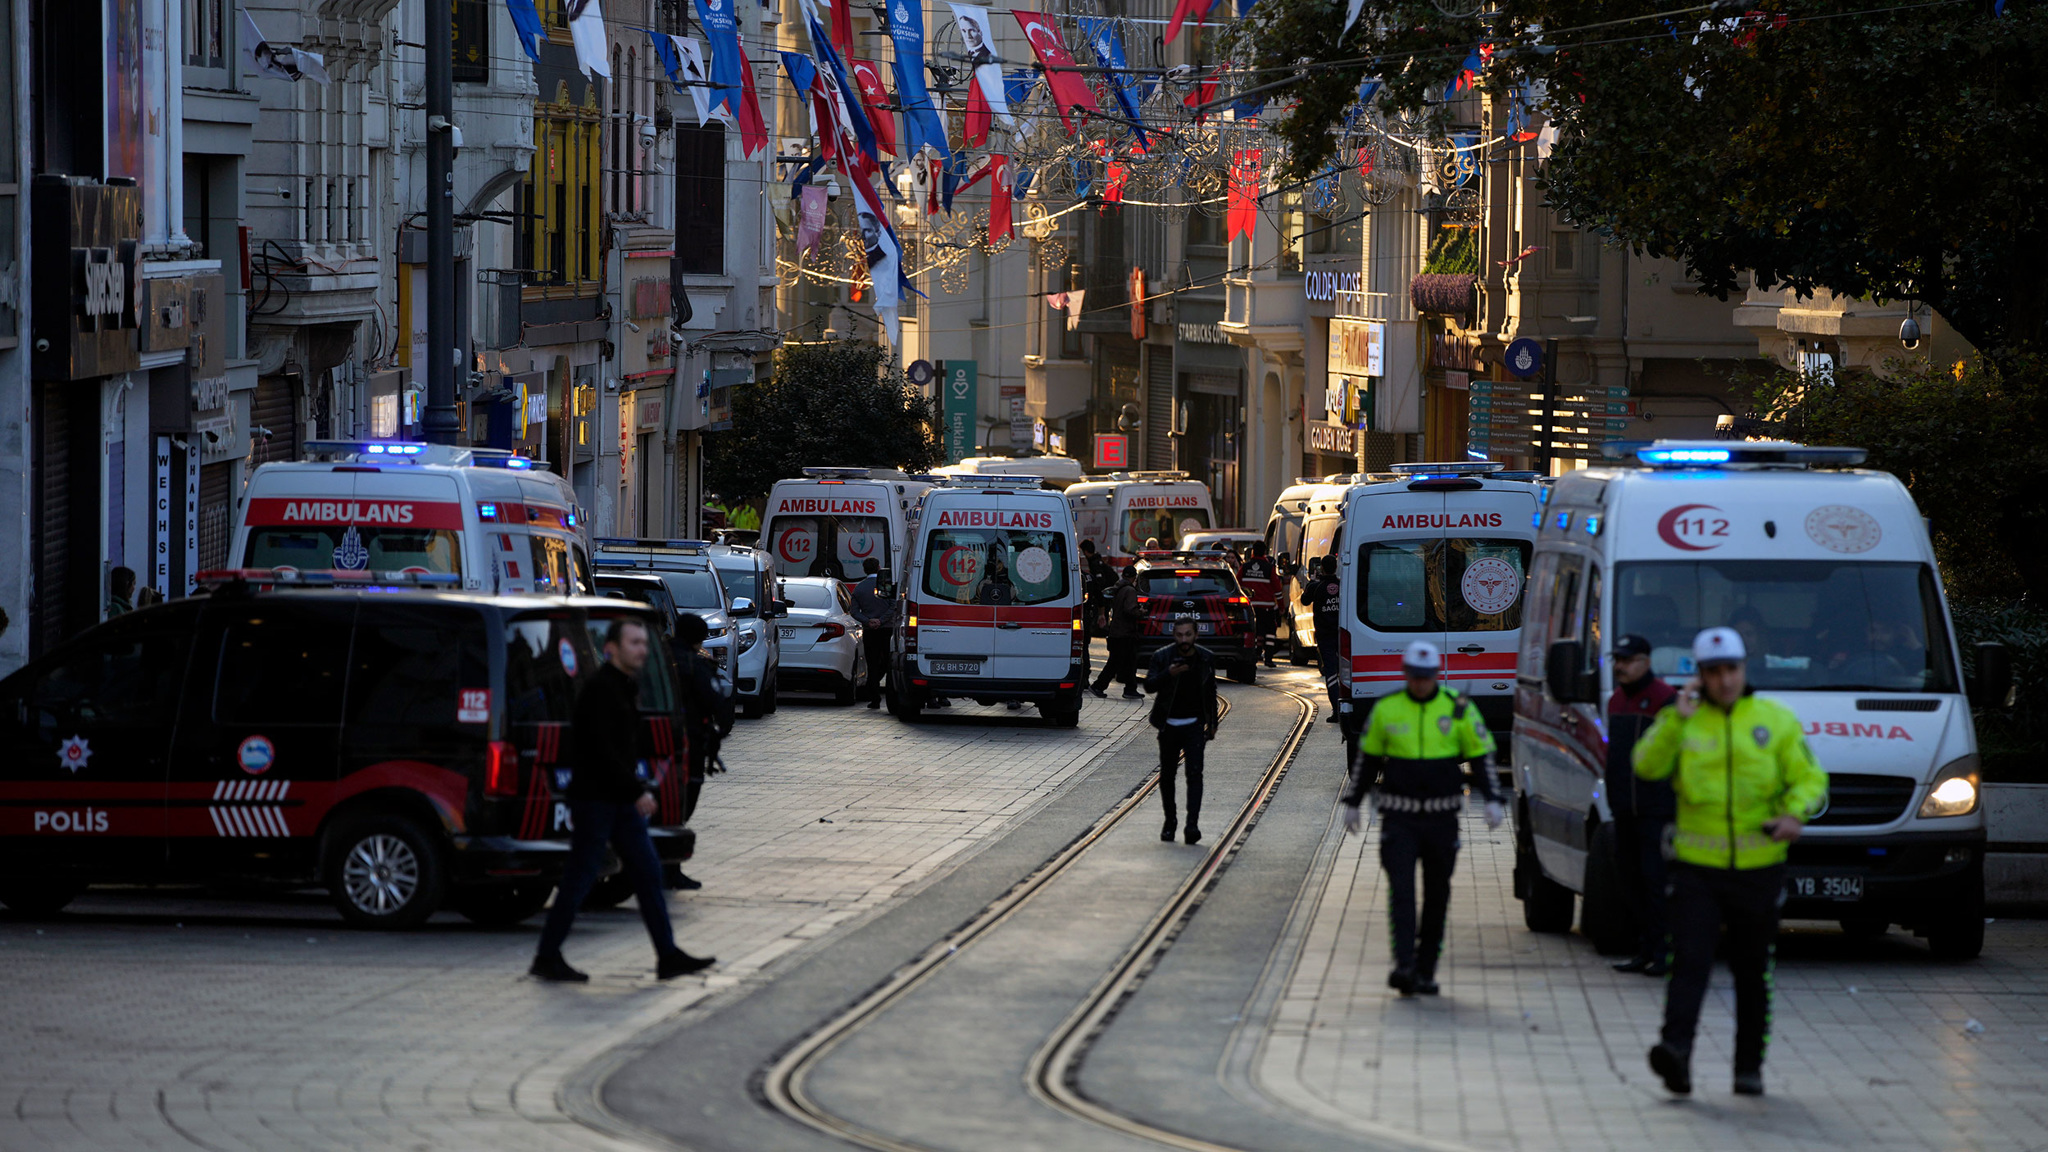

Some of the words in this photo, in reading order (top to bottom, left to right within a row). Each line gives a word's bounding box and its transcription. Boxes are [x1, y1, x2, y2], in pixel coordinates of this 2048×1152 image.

[1305, 271, 1338, 301] GOLDEN
[1340, 271, 1361, 302] ROSE
[1178, 322, 1211, 343] STARBUCKS
[1311, 427, 1335, 451] GOLDEN
[1336, 429, 1352, 452] ROSE
[1103, 442, 1120, 461] E
[188, 446, 196, 549] CHANGE
[779, 499, 876, 513] AMBULANS
[1128, 497, 1198, 507] AMBULANS
[283, 502, 413, 524] AMBULANS
[938, 511, 1052, 528] AMBULANS
[1382, 513, 1502, 529] AMBULANS
[1676, 518, 1730, 536] 112
[787, 538, 810, 552] 112
[949, 558, 976, 574] 112
[781, 629, 794, 637] 397
[935, 663, 945, 671] 34
[947, 663, 957, 671] BH
[958, 663, 979, 671] 5720
[462, 690, 486, 709] 112
[34, 805, 109, 832] POLİS
[1822, 876, 1861, 896] 3504
